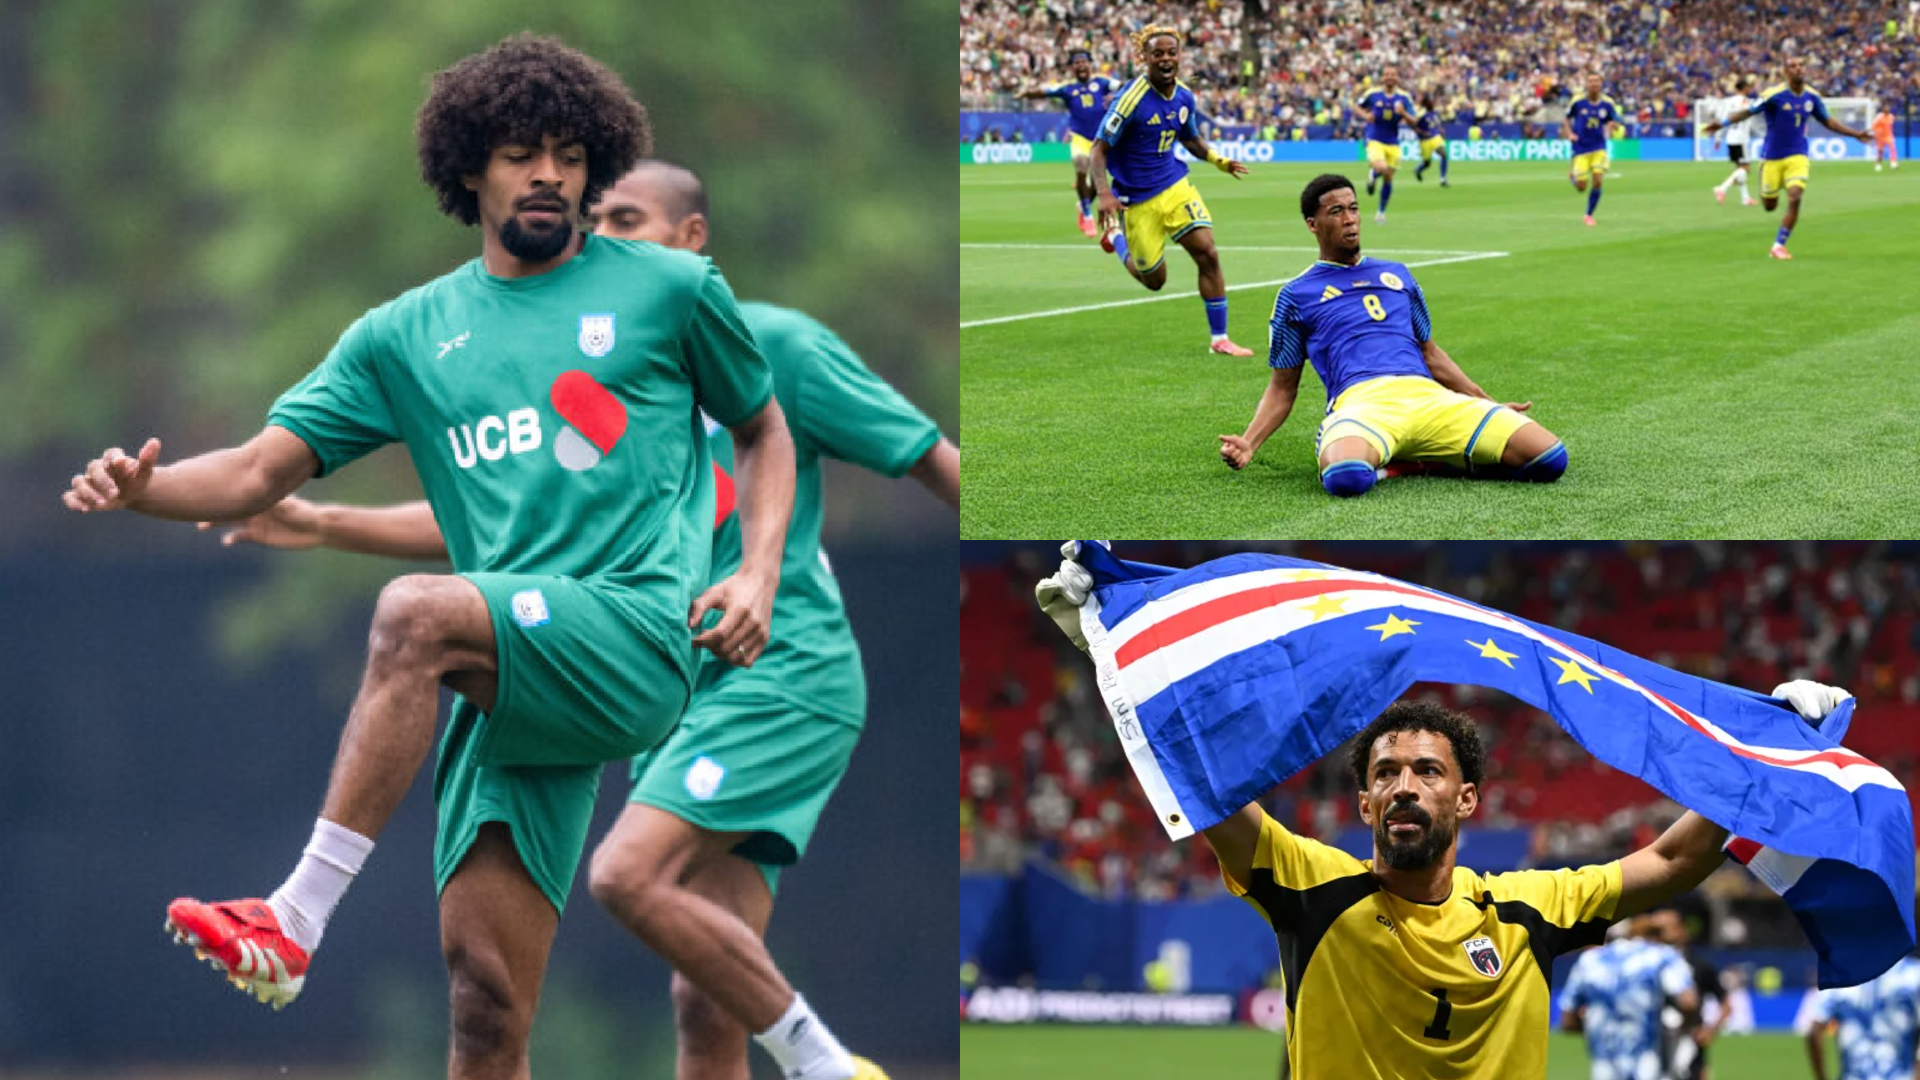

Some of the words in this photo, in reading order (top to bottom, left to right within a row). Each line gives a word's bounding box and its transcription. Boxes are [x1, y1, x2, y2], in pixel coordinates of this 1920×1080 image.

[1158, 130, 1176, 153] 12
[1450, 140, 1524, 160] ENERGY
[972, 143, 1032, 164] aramco
[1185, 201, 1208, 221] 12
[1362, 294, 1387, 321] 8
[448, 407, 542, 469] UCB
[1465, 938, 1489, 950] FCF
[1423, 988, 1452, 1041] 1
